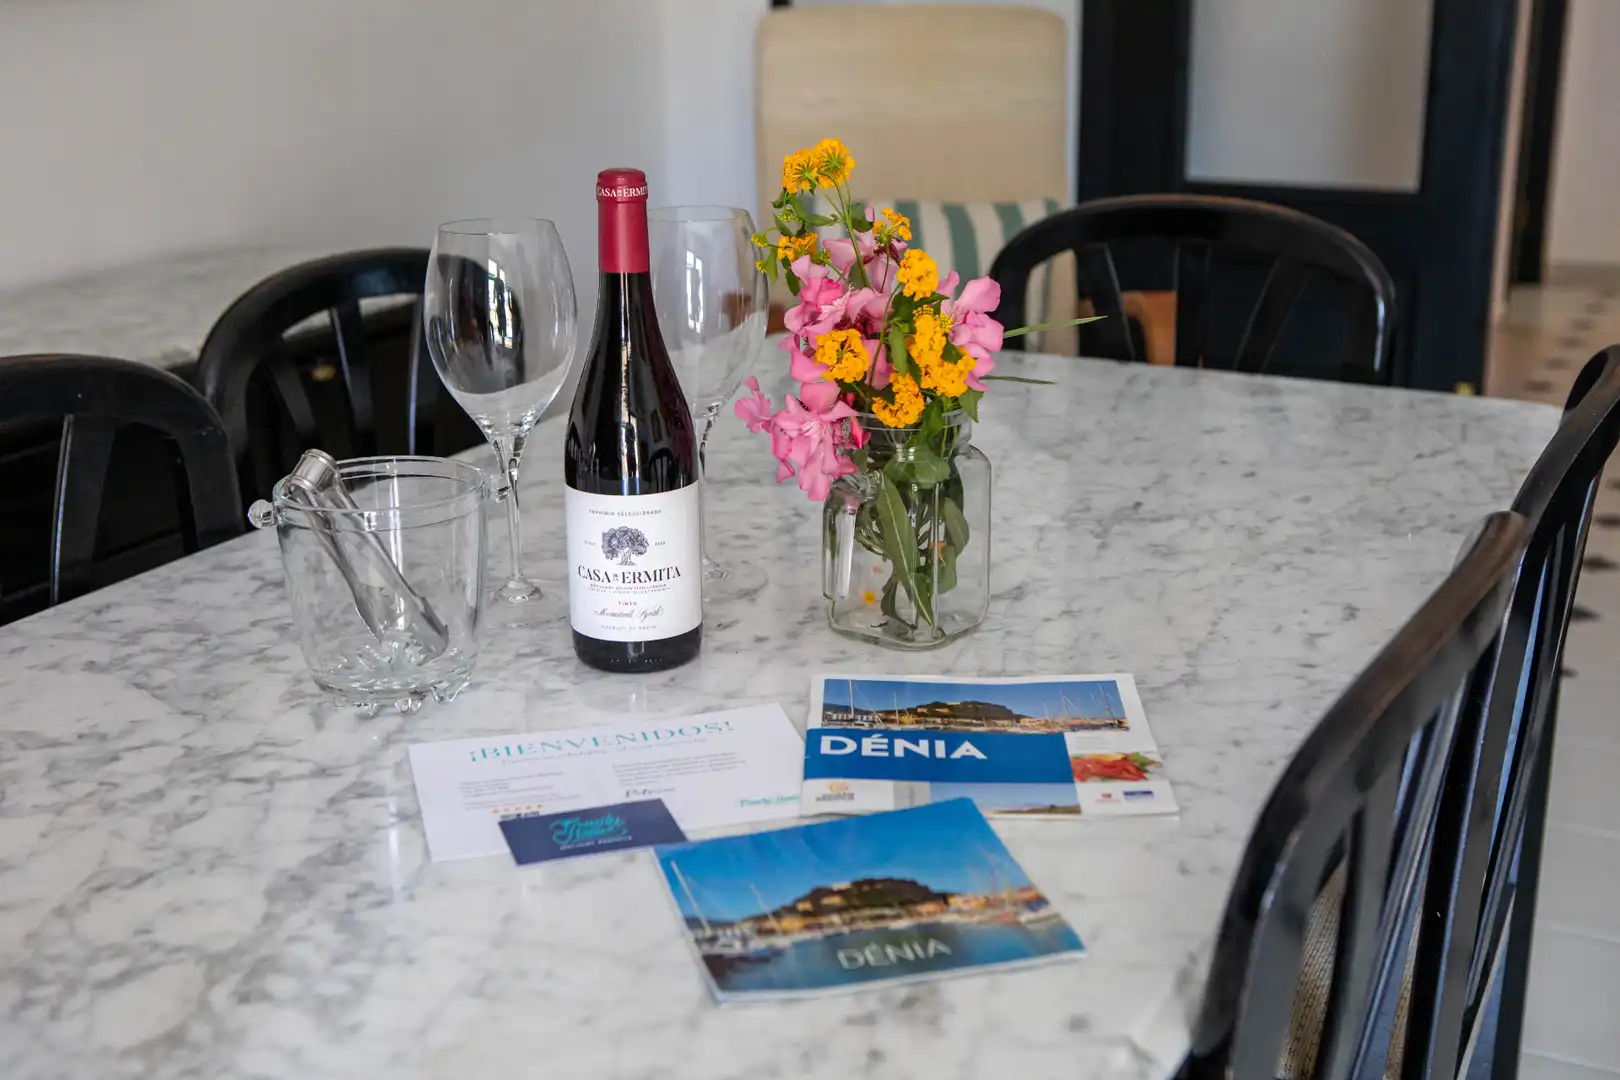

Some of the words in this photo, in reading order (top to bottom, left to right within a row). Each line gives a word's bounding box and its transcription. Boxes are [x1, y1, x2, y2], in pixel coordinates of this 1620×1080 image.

[578, 565, 611, 583] CASA
[622, 566, 681, 584] ERMITA
[820, 733, 988, 760] DÉNIA
[837, 937, 952, 970] DÉNIA
